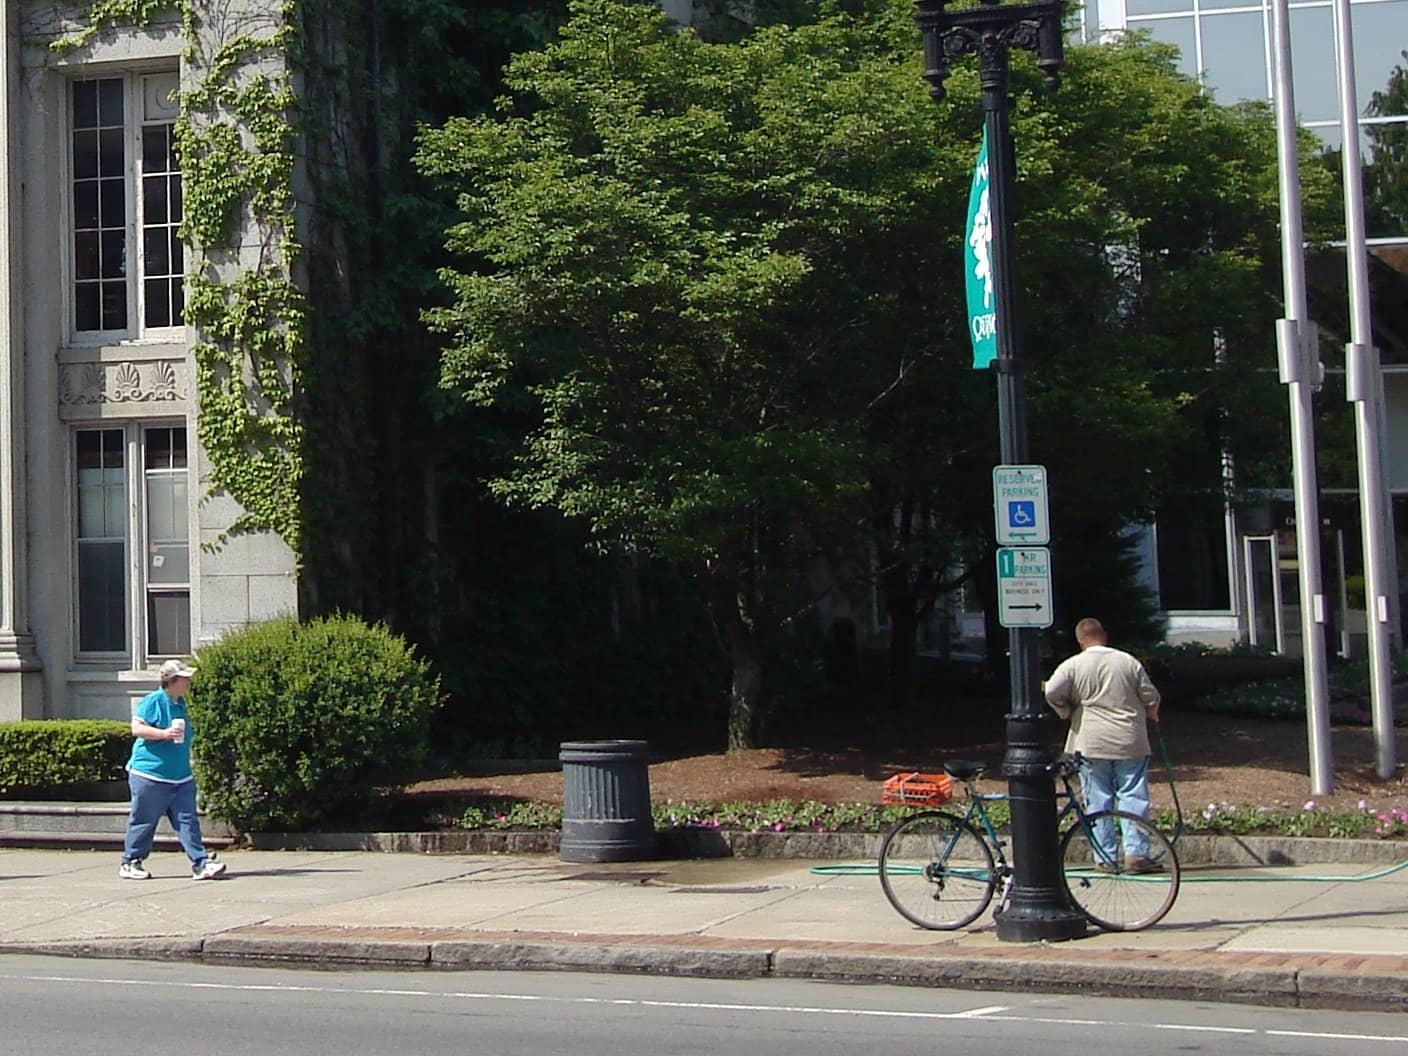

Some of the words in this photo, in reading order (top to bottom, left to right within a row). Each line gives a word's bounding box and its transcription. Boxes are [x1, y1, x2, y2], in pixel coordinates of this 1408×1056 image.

[997, 472, 1042, 485] RESERVE
[1001, 487, 1040, 497] PARKING
[1015, 564, 1047, 575] PARKING
